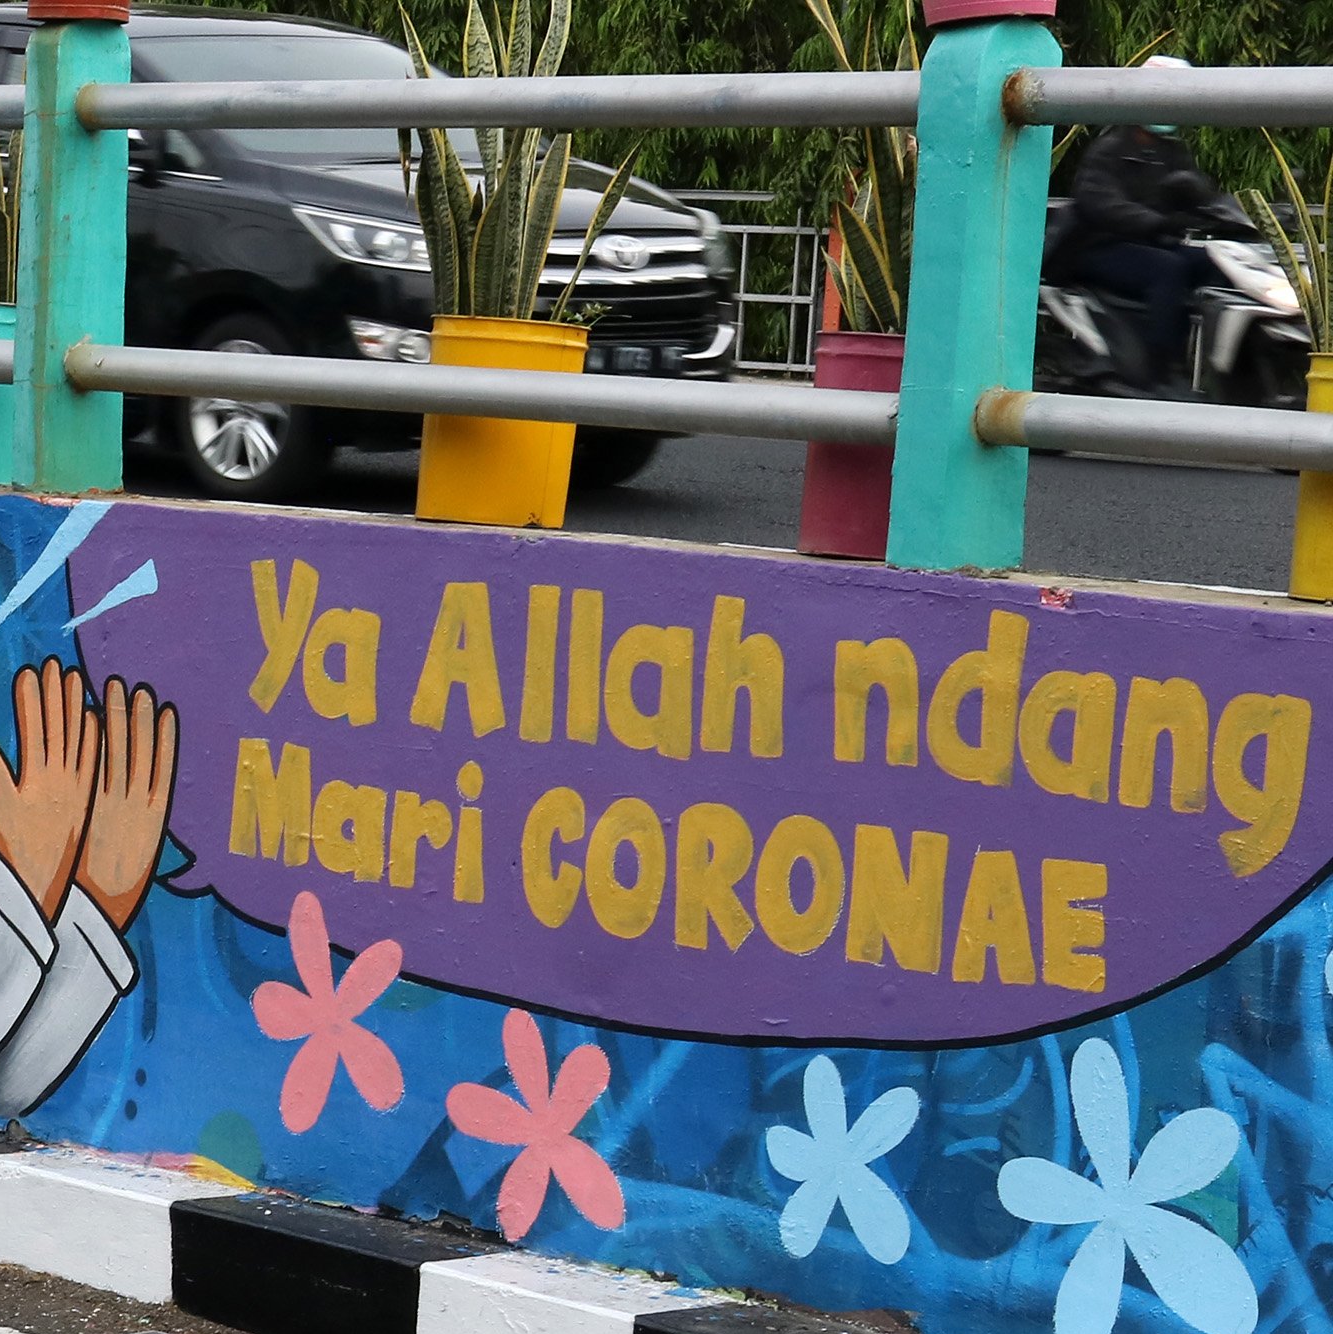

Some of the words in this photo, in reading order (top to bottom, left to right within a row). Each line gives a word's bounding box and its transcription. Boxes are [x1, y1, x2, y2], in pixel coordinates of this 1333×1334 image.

[249, 558, 381, 727] Ya
[410, 581, 785, 761] Allah
[835, 610, 1312, 878] ndang
[229, 737, 485, 905] Mari
[521, 786, 1108, 993] CORONAE
